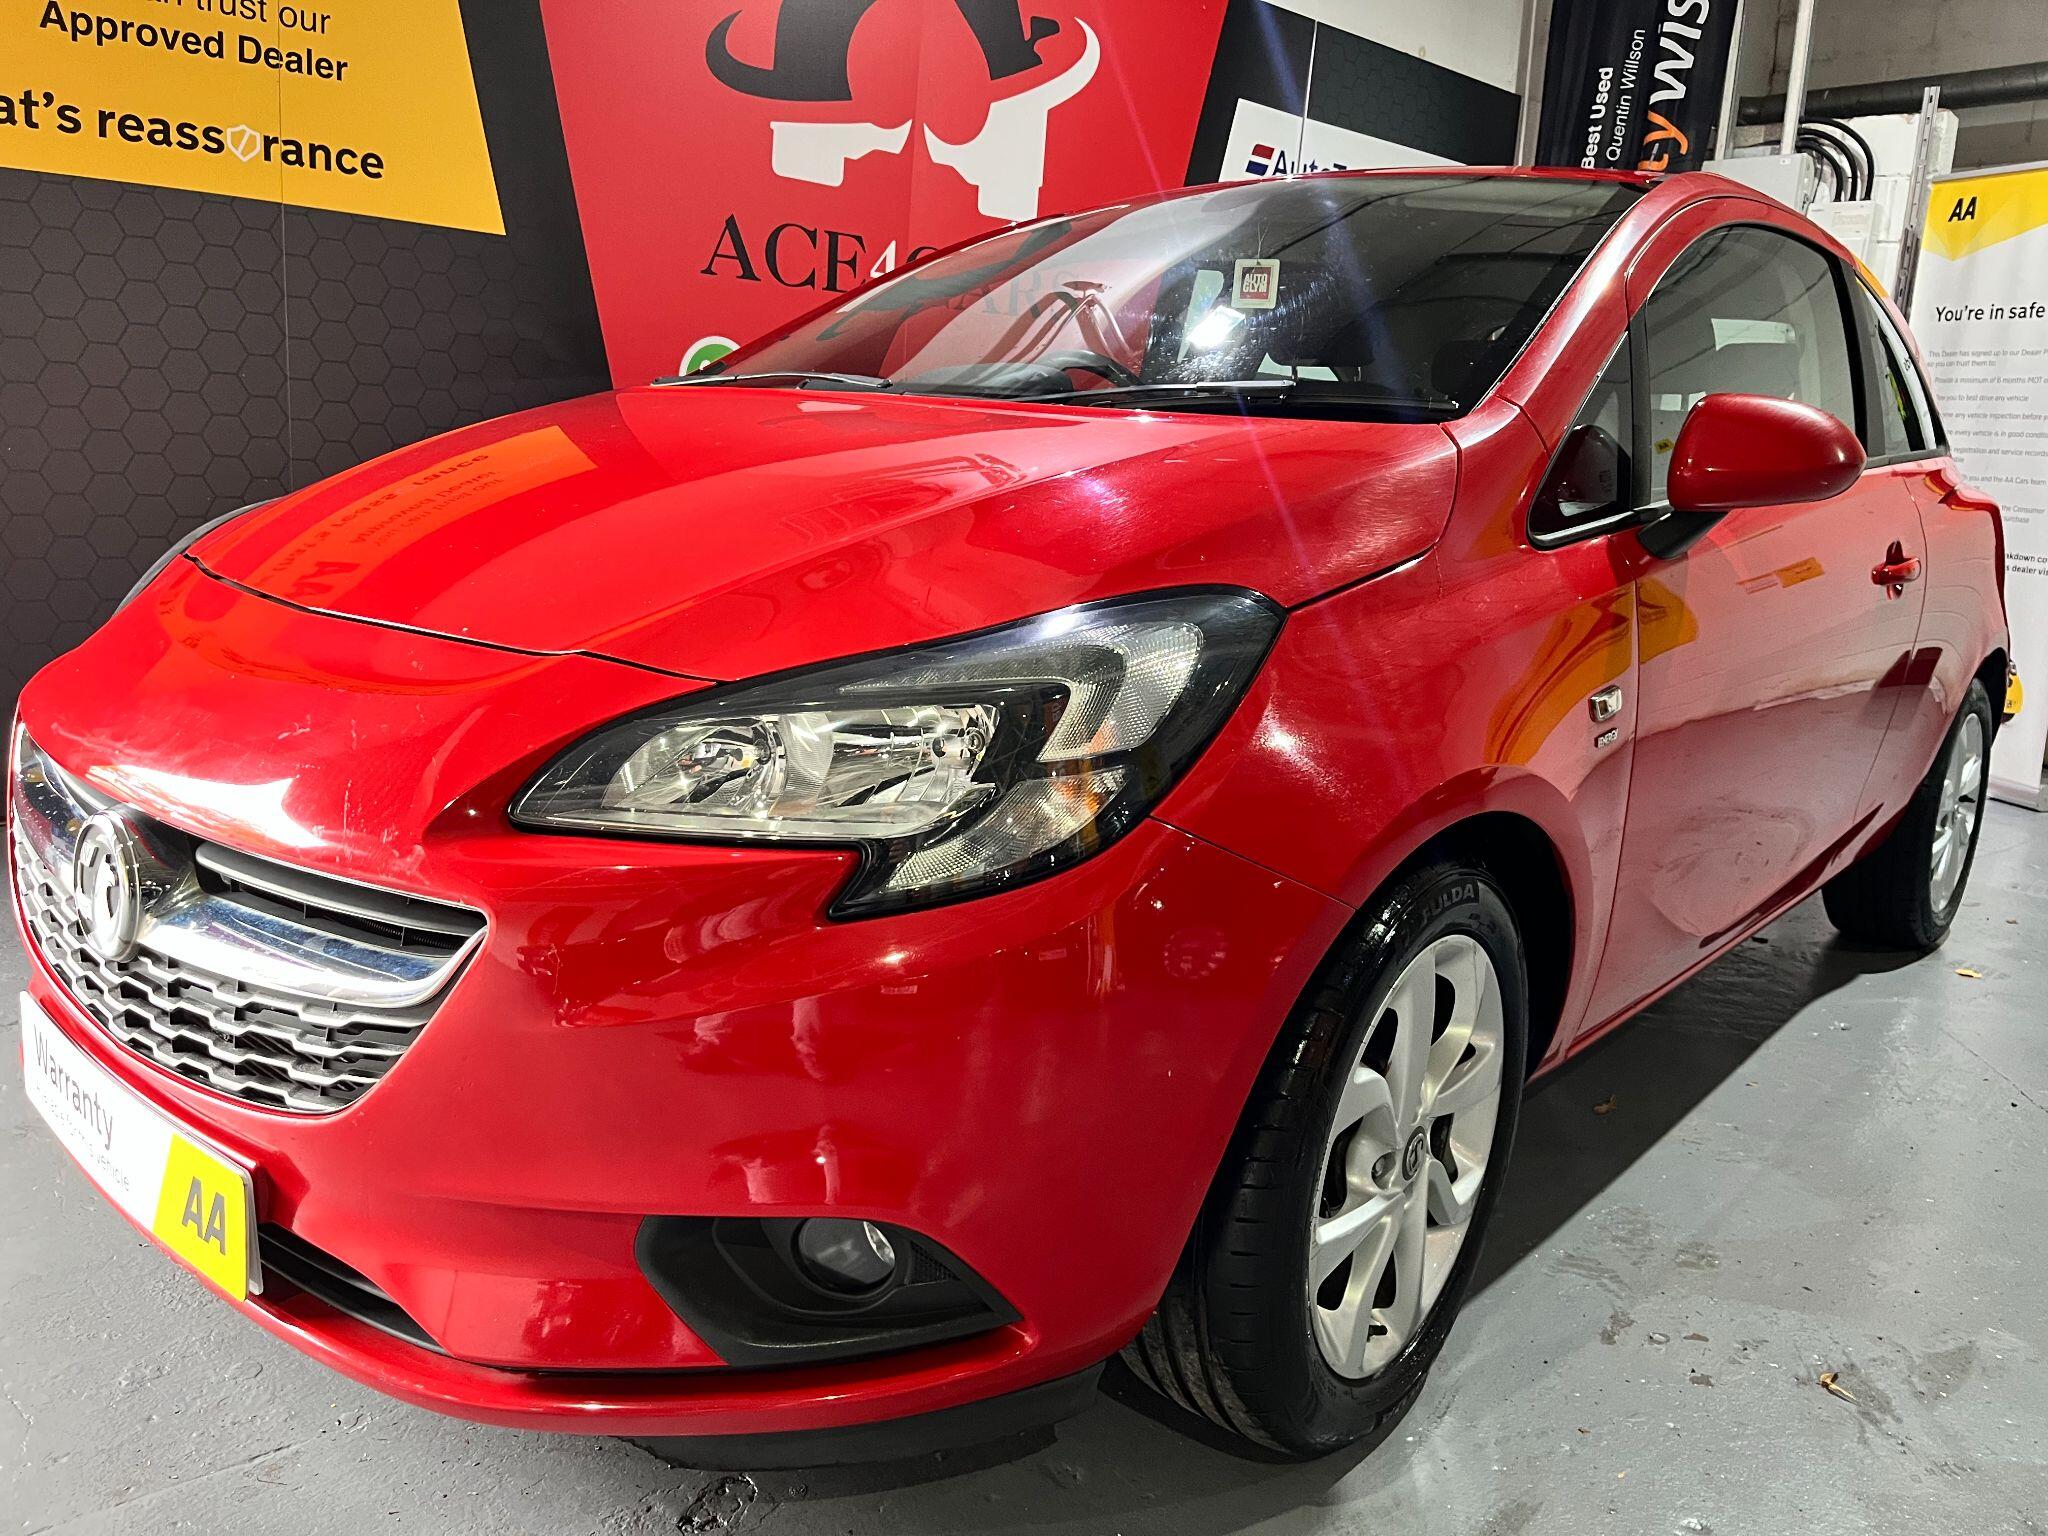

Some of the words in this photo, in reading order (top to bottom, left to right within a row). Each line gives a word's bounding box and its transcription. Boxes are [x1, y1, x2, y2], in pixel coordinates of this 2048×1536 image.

[279, 6, 331, 34] our
[39, 0, 225, 59] Approved
[237, 33, 349, 82] Dealer
[1589, 67, 1614, 119] Used
[1605, 95, 1632, 161] Quentin
[1619, 29, 1646, 90] Willson
[1580, 124, 1603, 170] Best
[1948, 196, 1978, 222] AA
[1242, 281, 1267, 293] GLYM
[1244, 273, 1268, 283] AUTO
[1935, 304, 1984, 323] You're
[1989, 303, 2005, 320] in
[2008, 301, 2046, 320] safe
[2011, 564, 2037, 574] dealer
[33, 1023, 114, 1151] Warranty
[181, 1175, 227, 1256] AA
